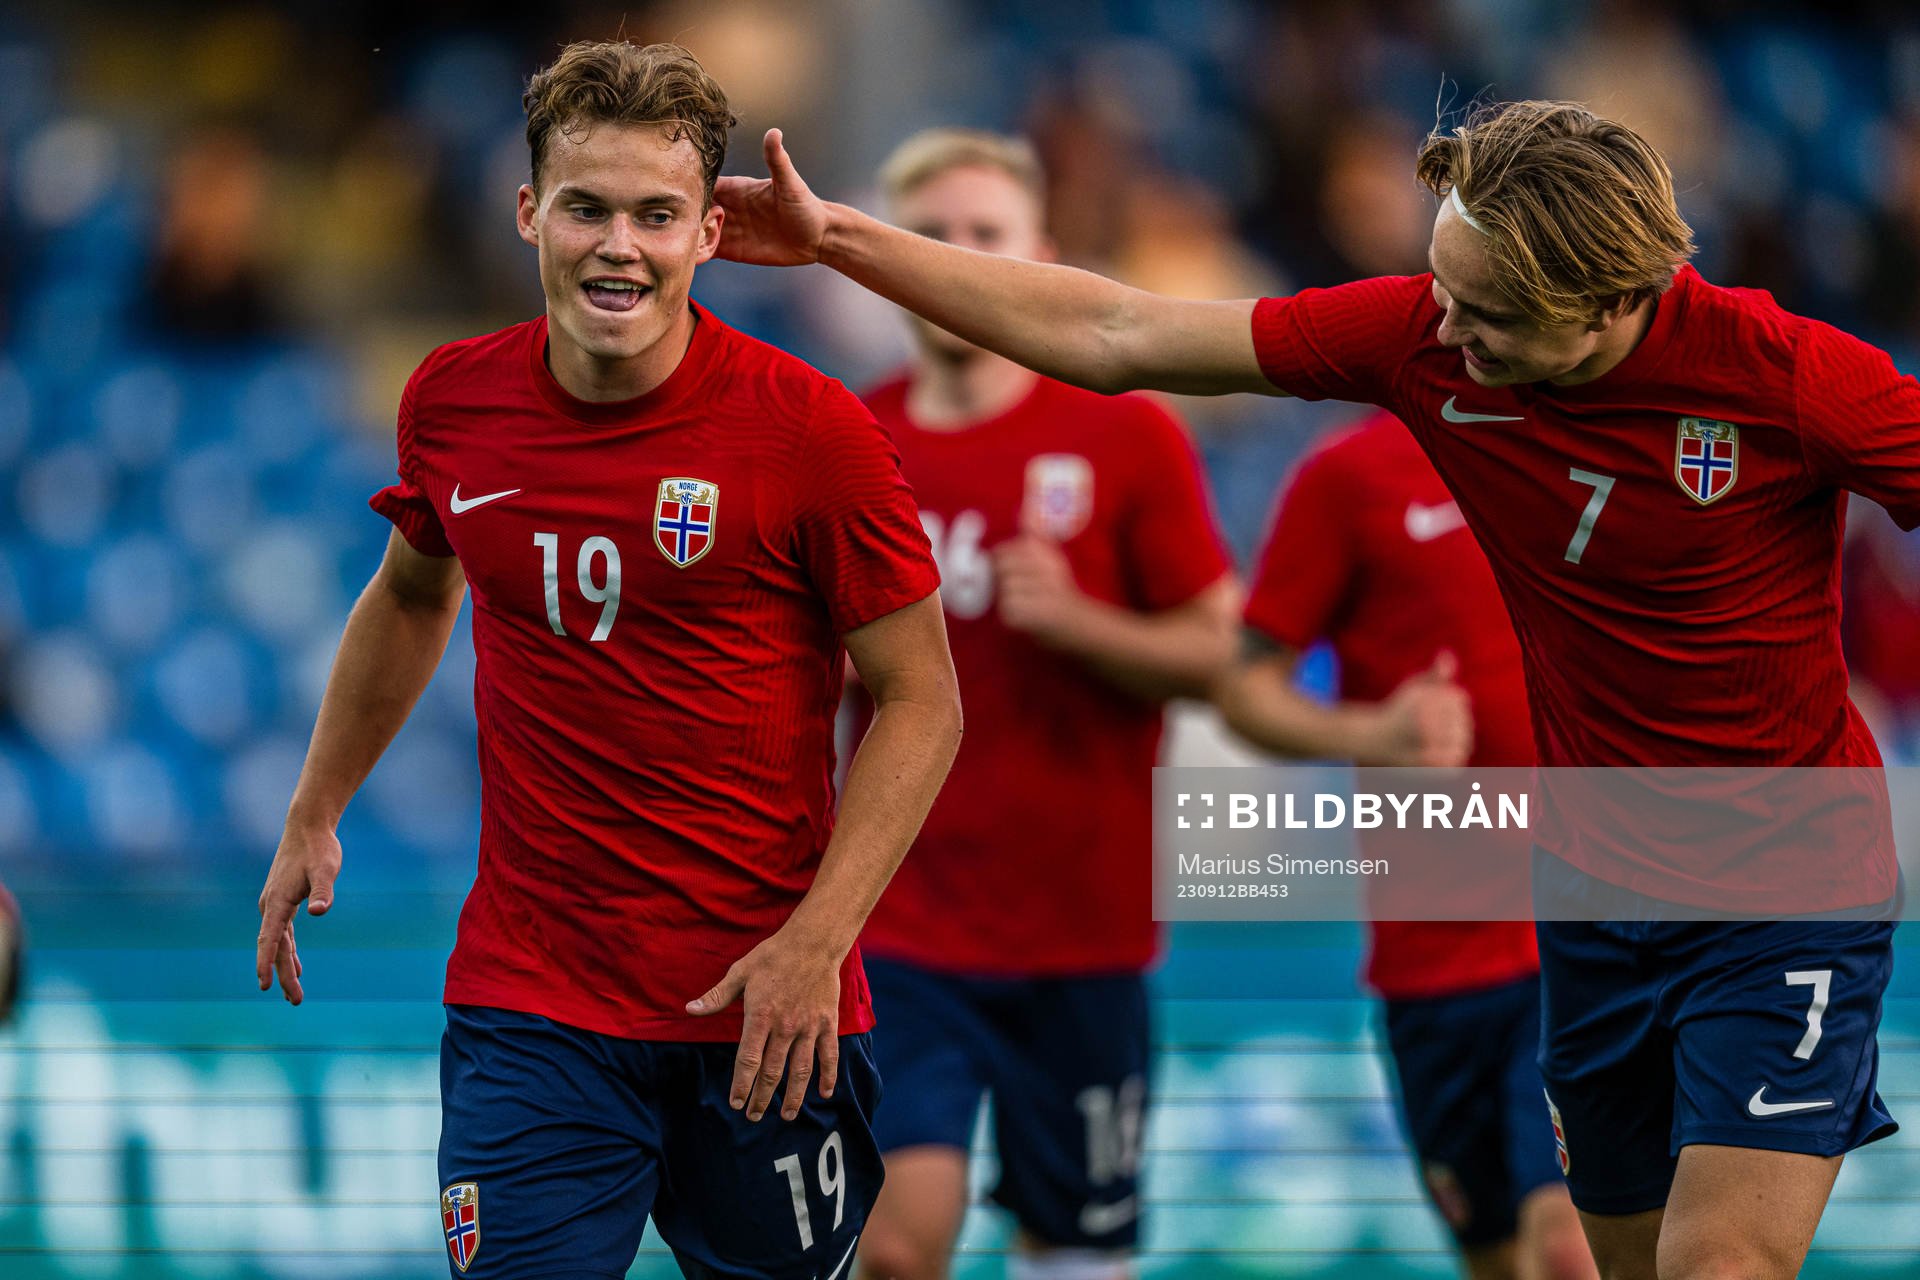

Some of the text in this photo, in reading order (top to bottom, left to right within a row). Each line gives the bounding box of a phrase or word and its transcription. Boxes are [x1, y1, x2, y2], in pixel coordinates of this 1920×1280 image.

[679, 481, 698, 492] NORGE
[1564, 466, 1616, 565] 7
[532, 531, 623, 643] 19
[1784, 969, 1833, 1060] 7
[773, 1130, 846, 1251] 19
